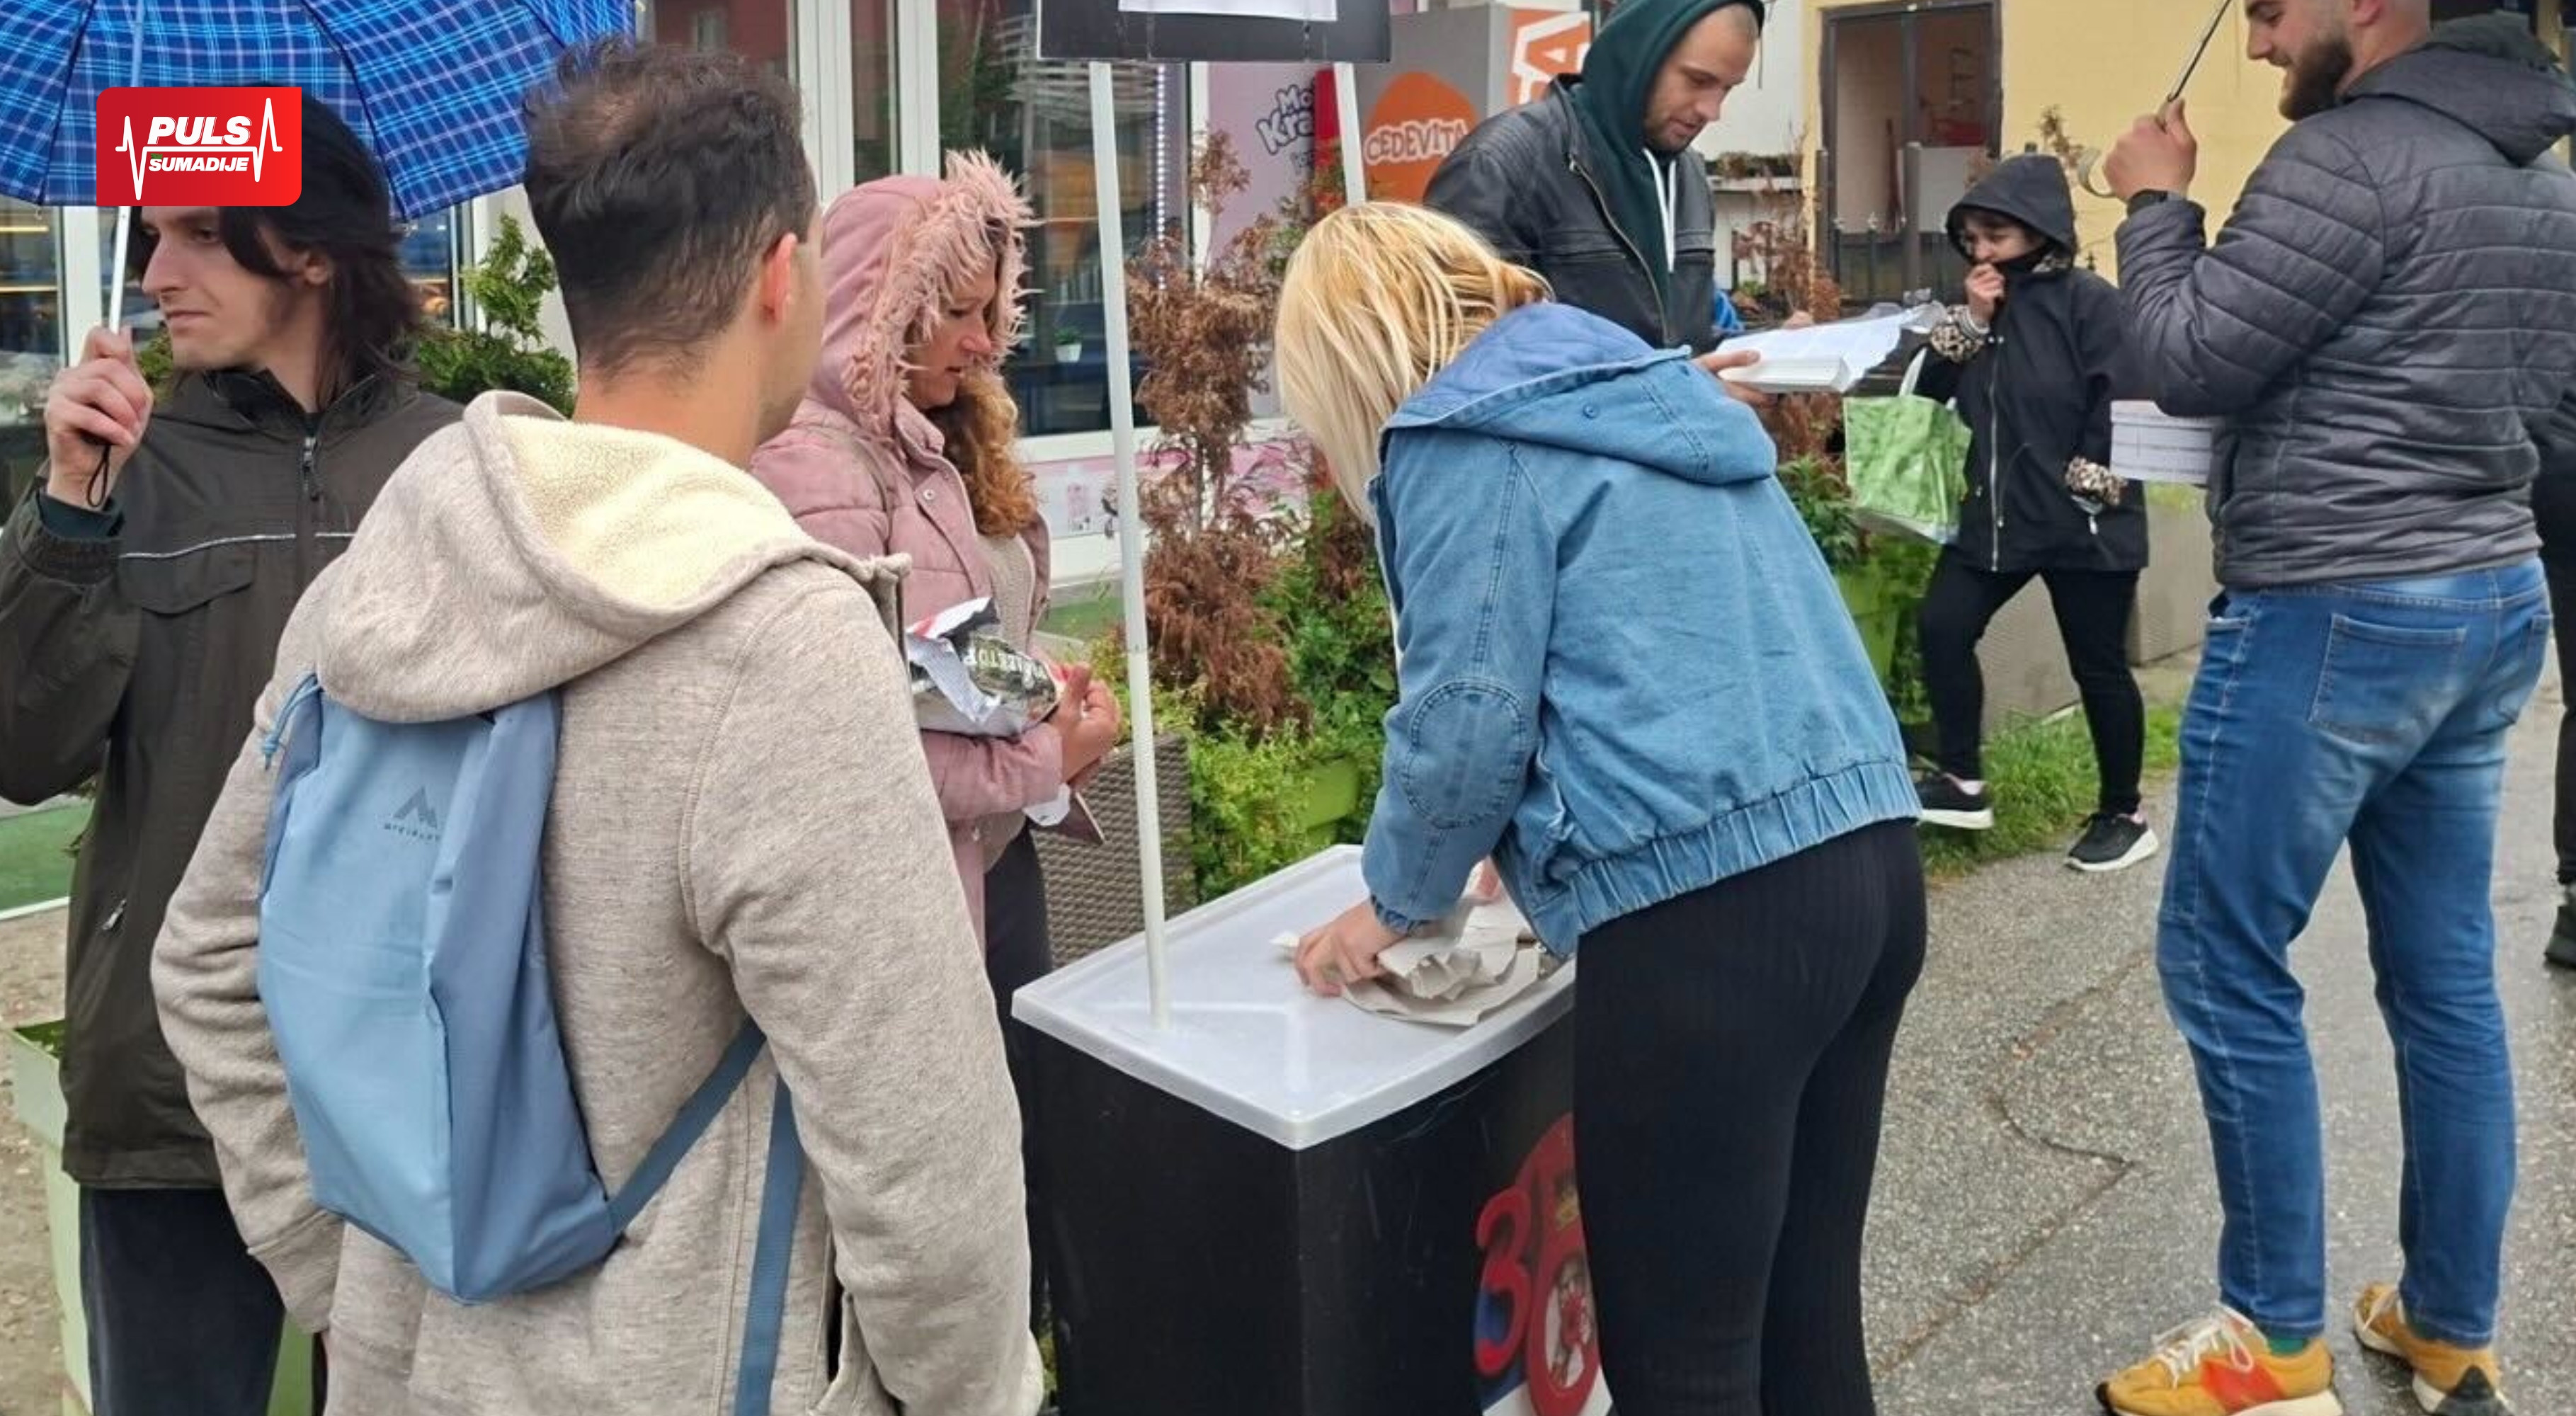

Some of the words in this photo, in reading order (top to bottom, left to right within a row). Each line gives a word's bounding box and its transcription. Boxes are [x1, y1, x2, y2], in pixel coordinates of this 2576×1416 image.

[1276, 84, 1315, 115] Mo
[1255, 108, 1315, 155] Kra
[1365, 119, 1468, 164] CEDEVITA
